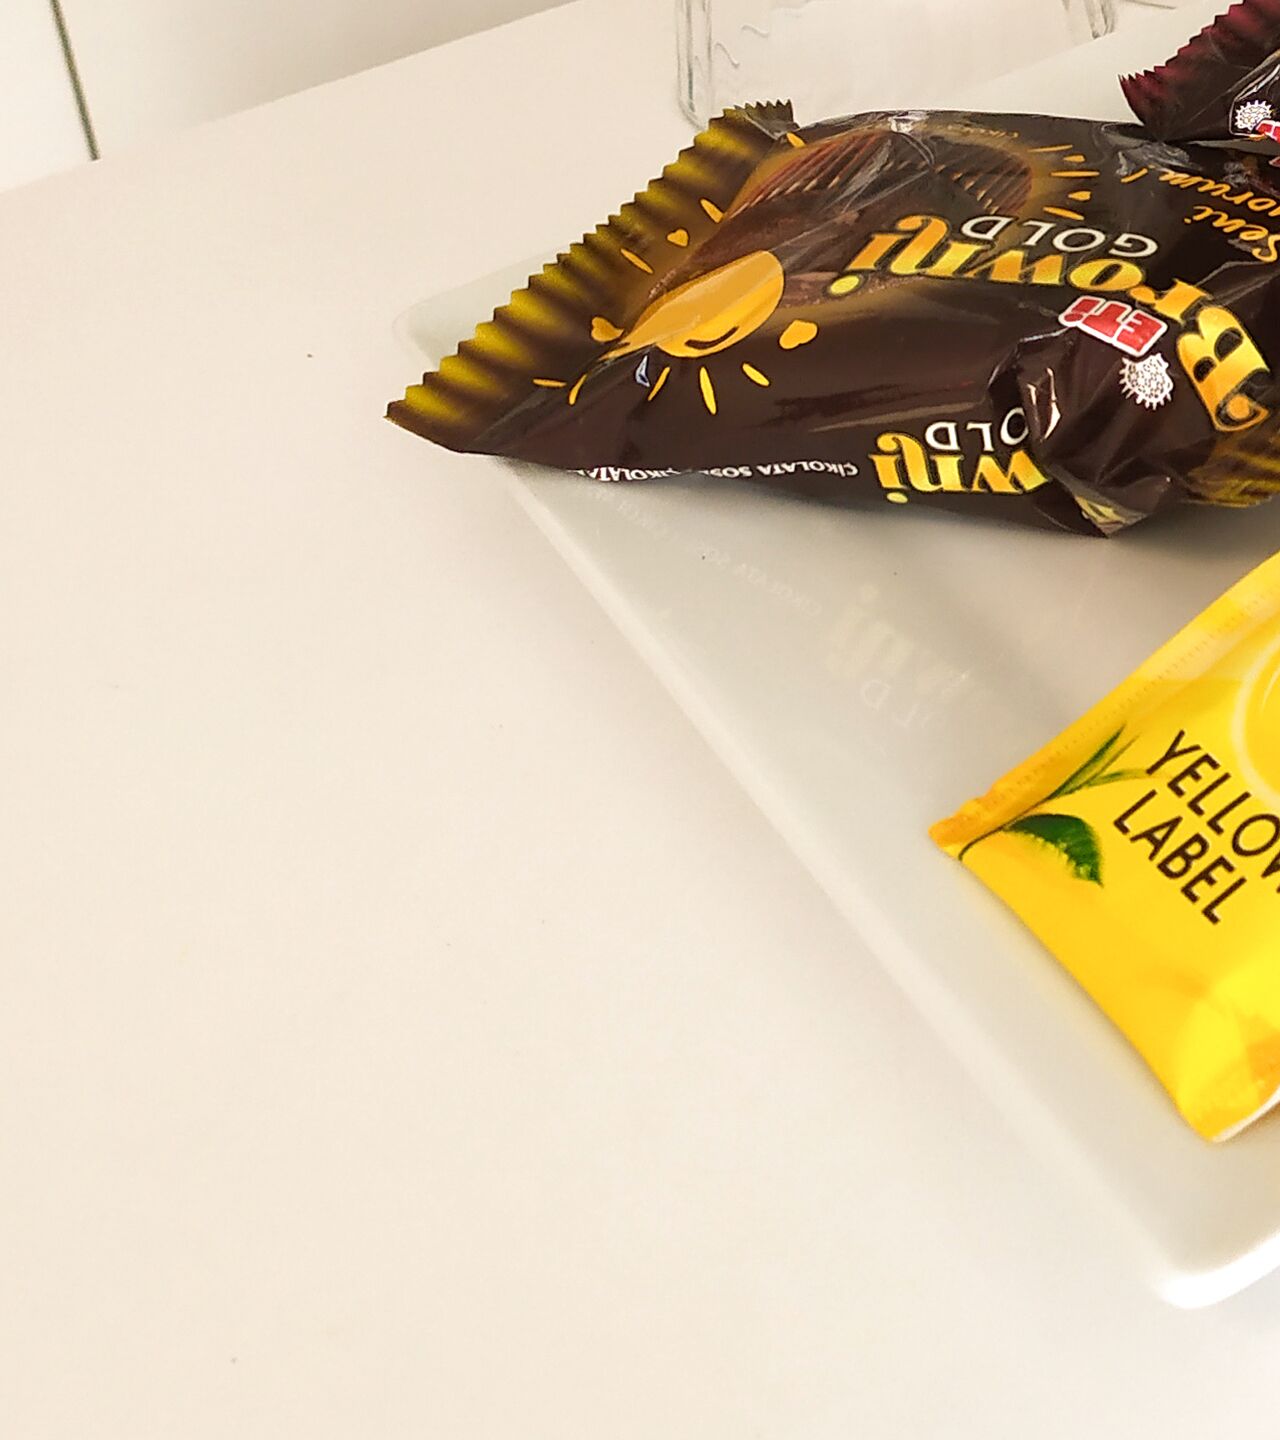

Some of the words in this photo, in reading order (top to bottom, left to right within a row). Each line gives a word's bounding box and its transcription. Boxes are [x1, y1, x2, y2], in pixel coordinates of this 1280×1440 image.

[962, 214, 1159, 258] GOLD
[926, 406, 1029, 452] OLD
[869, 431, 1049, 504] wni
[1111, 790, 1248, 928] LABEL
